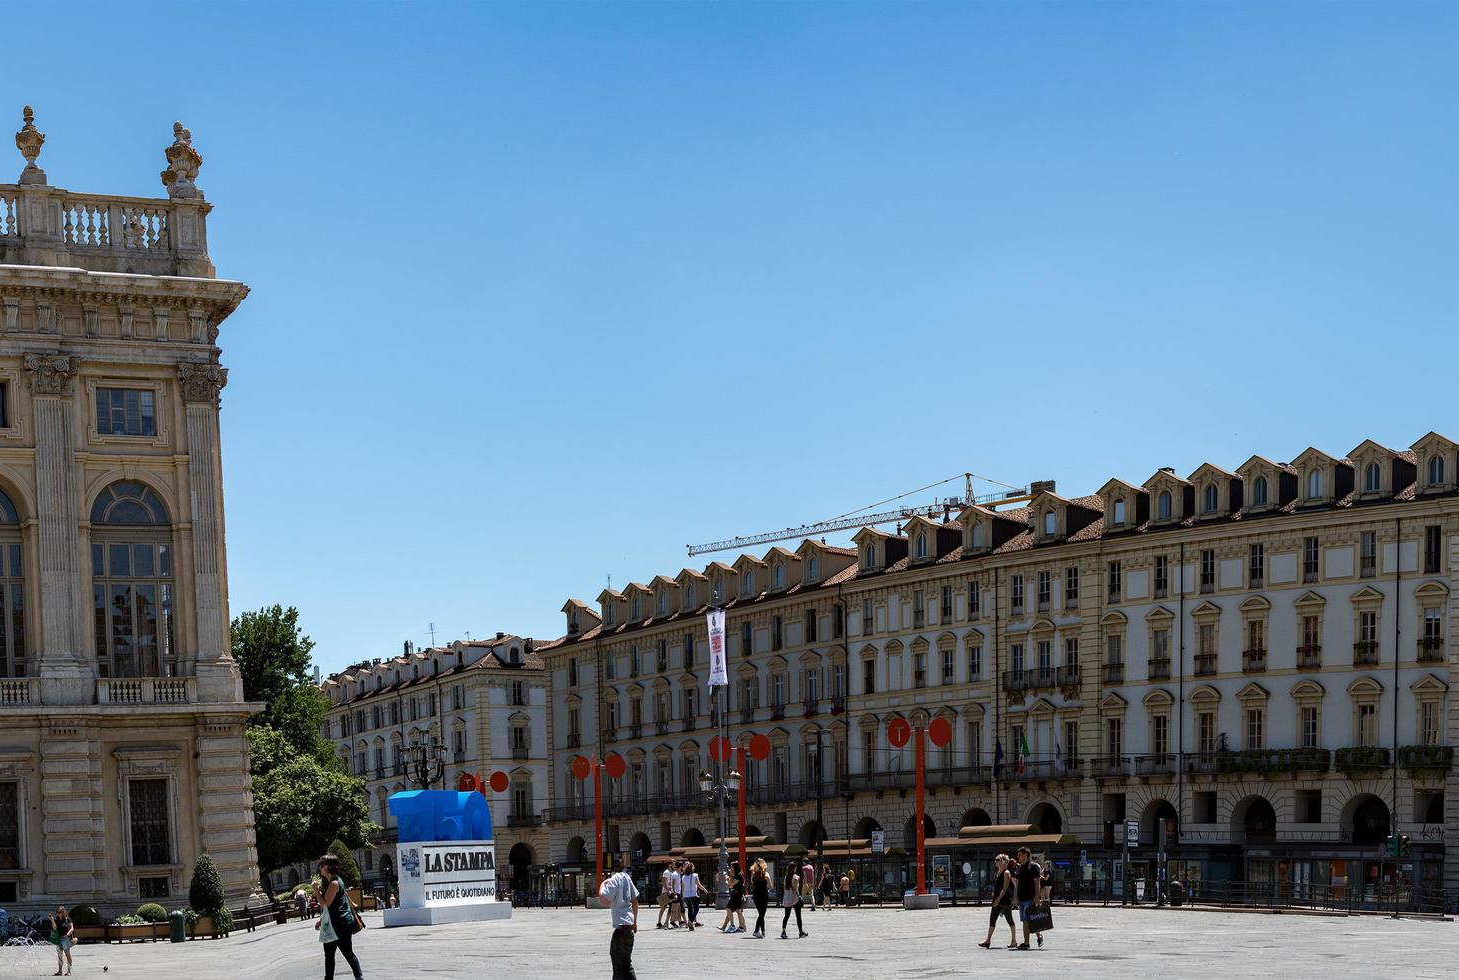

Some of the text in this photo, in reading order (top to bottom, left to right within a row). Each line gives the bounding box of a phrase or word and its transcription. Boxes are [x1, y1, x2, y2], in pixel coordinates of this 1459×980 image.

[894, 726, 904, 742] T
[424, 853, 443, 873] LA
[444, 851, 495, 873] STAMPA
[425, 886, 495, 901] IL FUTURO È QUOTIDIANO
